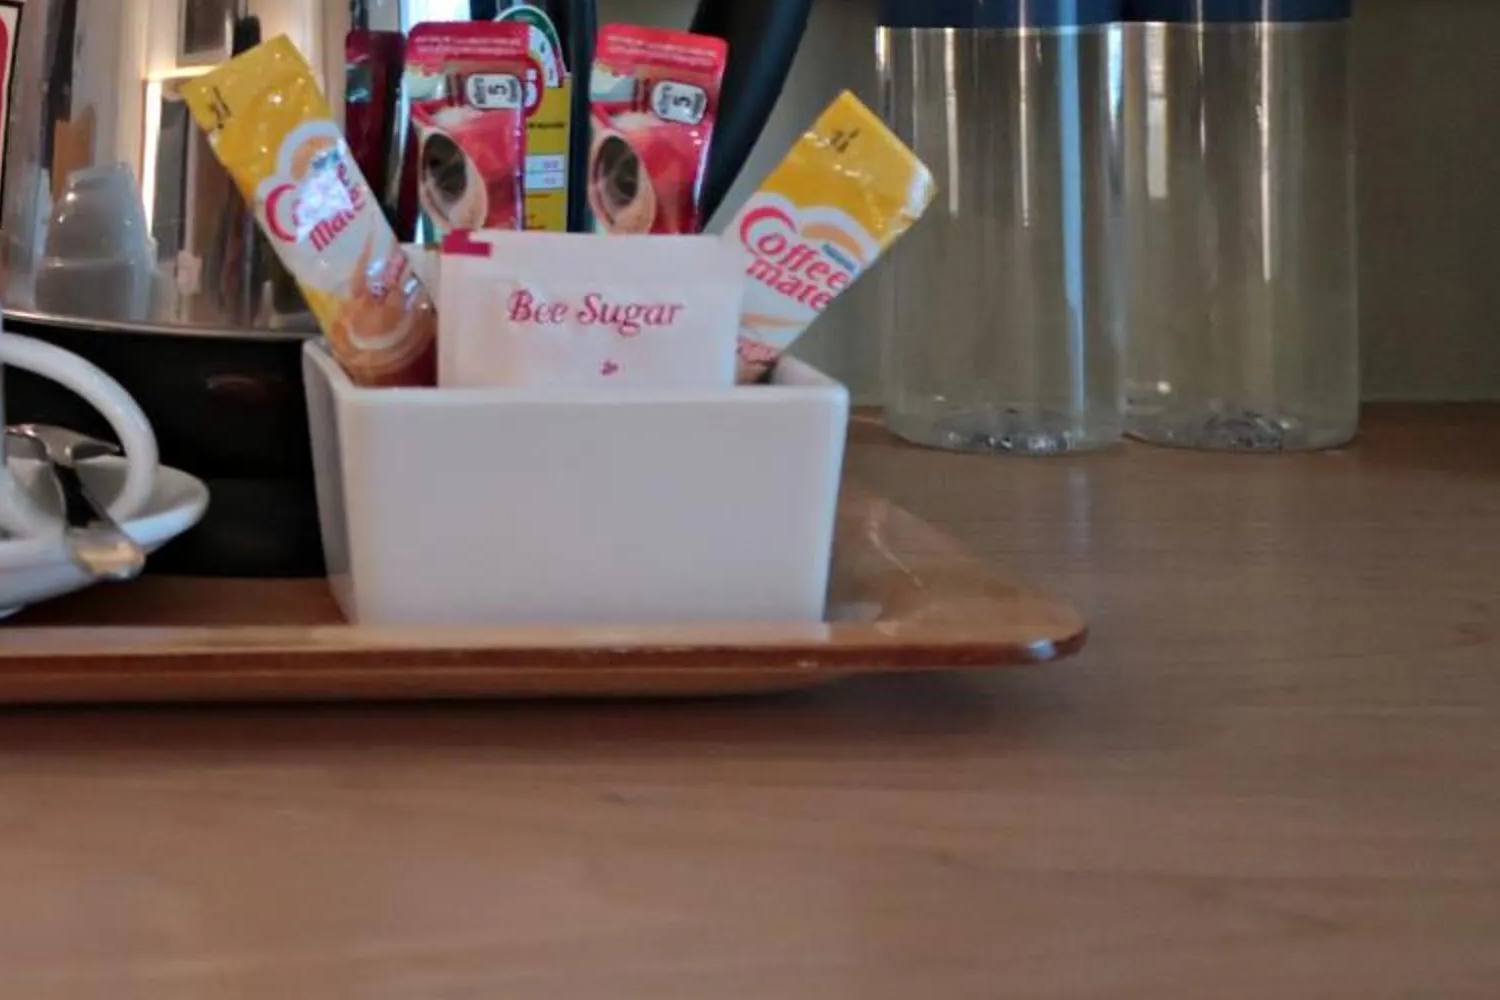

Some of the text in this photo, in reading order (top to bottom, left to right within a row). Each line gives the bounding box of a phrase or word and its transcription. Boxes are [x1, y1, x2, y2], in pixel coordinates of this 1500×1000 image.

[739, 205, 850, 291] Coffee
[745, 256, 836, 312] mate
[508, 288, 687, 338] Bee Sugar
